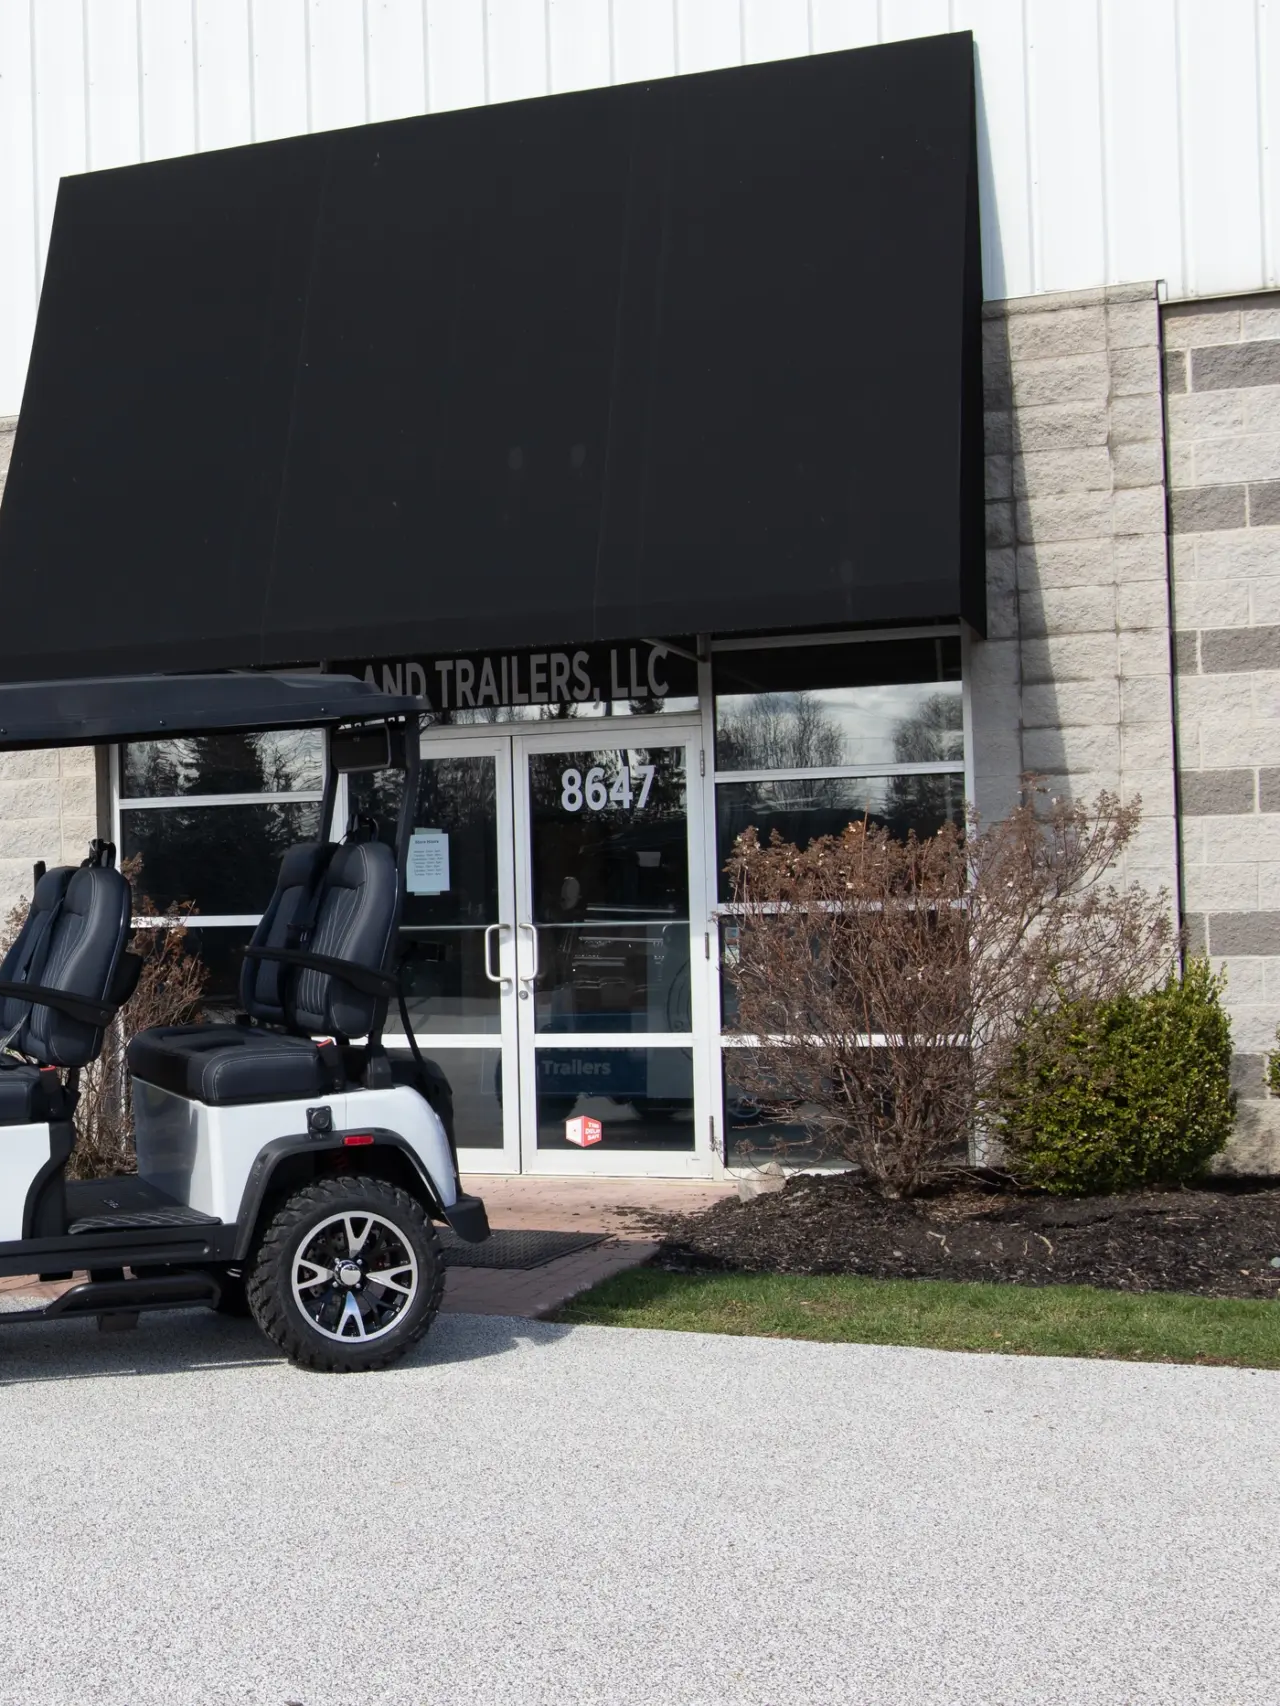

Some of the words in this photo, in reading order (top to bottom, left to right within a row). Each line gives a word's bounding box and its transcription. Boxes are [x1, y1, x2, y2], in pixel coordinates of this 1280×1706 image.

[435, 650, 601, 709] TRAILERS,
[610, 646, 669, 698] LLC
[561, 765, 656, 812] 8647
[542, 1059, 611, 1075] Trailers
